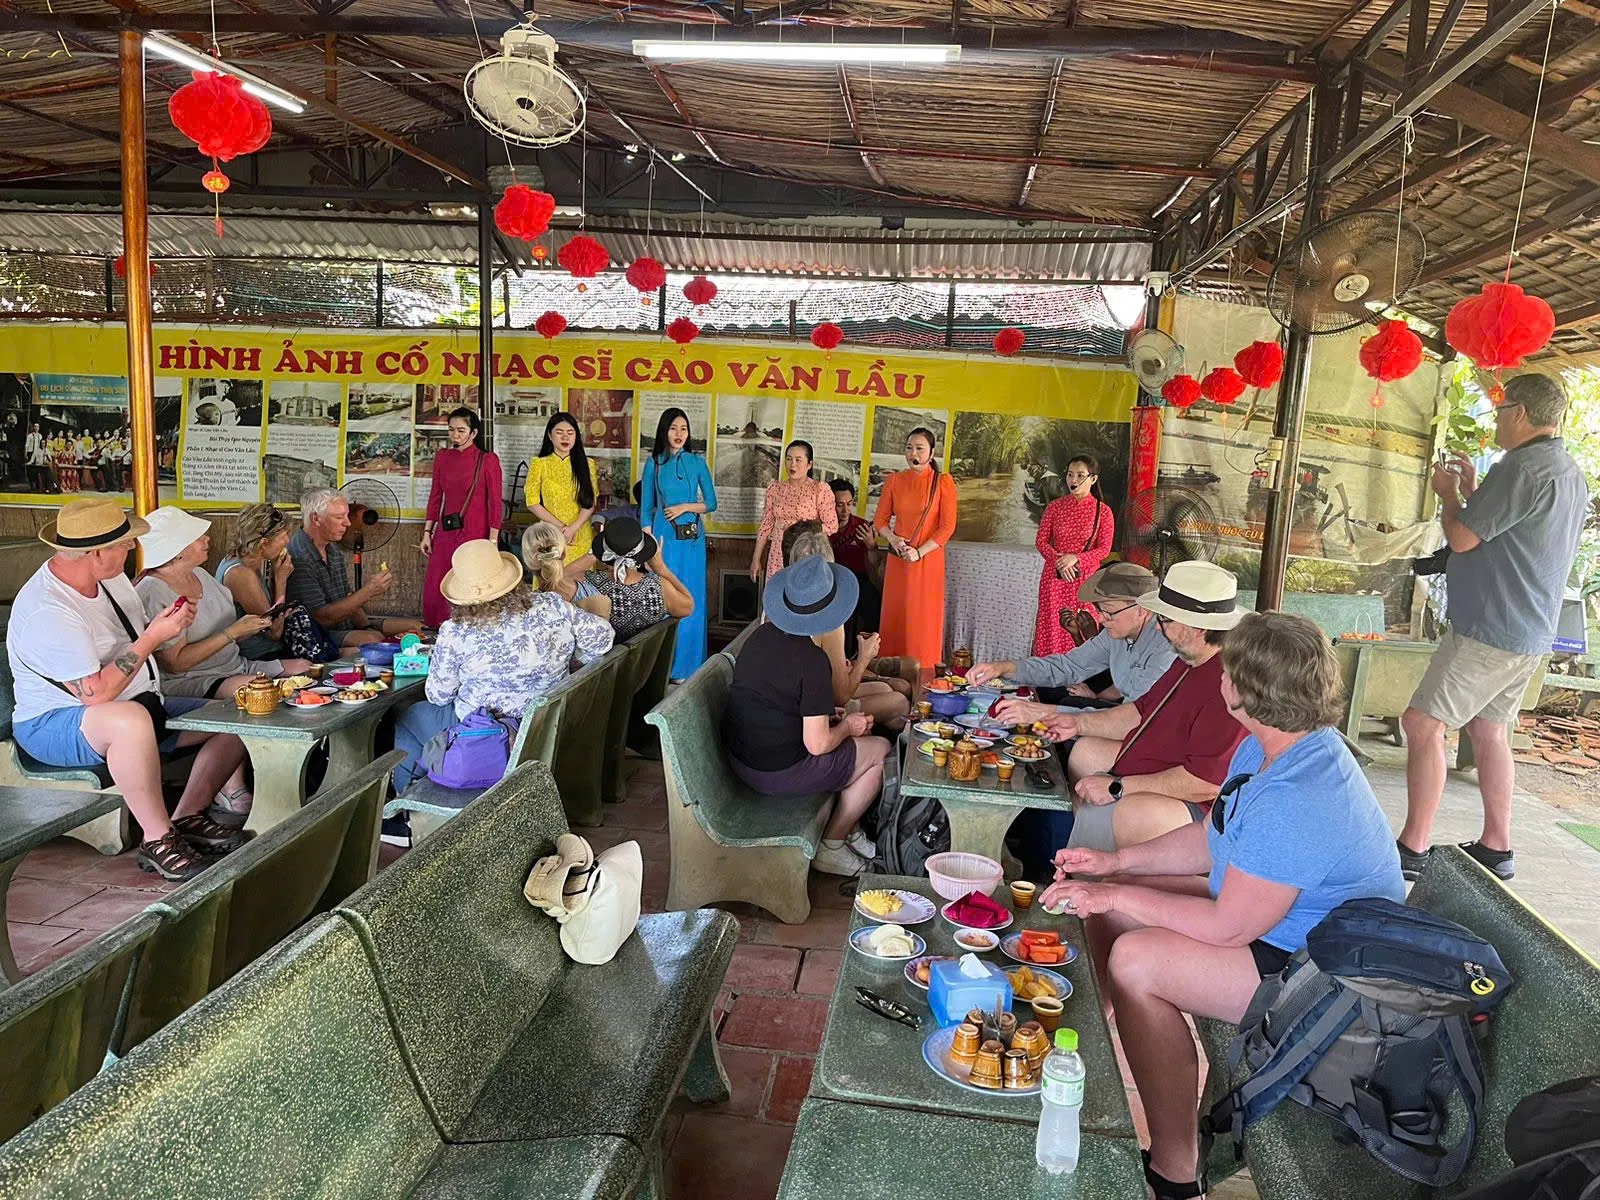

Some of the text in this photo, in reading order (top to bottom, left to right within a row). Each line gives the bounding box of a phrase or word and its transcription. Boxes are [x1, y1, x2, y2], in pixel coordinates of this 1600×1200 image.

[158, 339, 926, 400] HÌNH ẢNH CỐ NHẠC SĨ CAO VĂN LẦU
